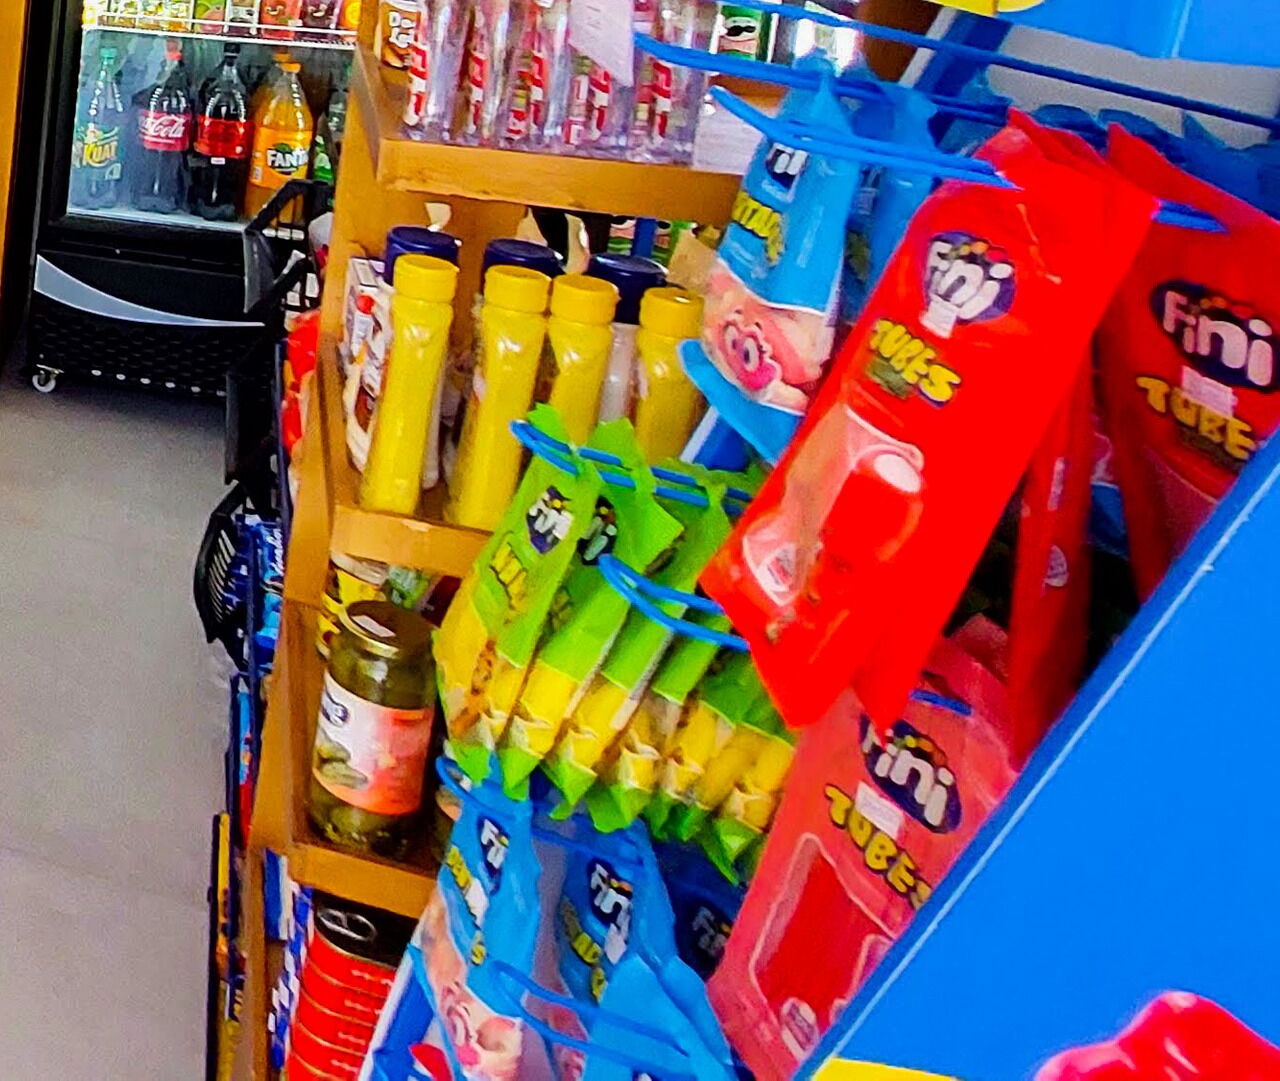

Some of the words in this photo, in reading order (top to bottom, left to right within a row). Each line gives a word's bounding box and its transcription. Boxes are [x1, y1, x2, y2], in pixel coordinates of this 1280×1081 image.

[928, 240, 1014, 320] Fini
[1162, 290, 1273, 387] Fini
[1135, 375, 1258, 461] TUBE
